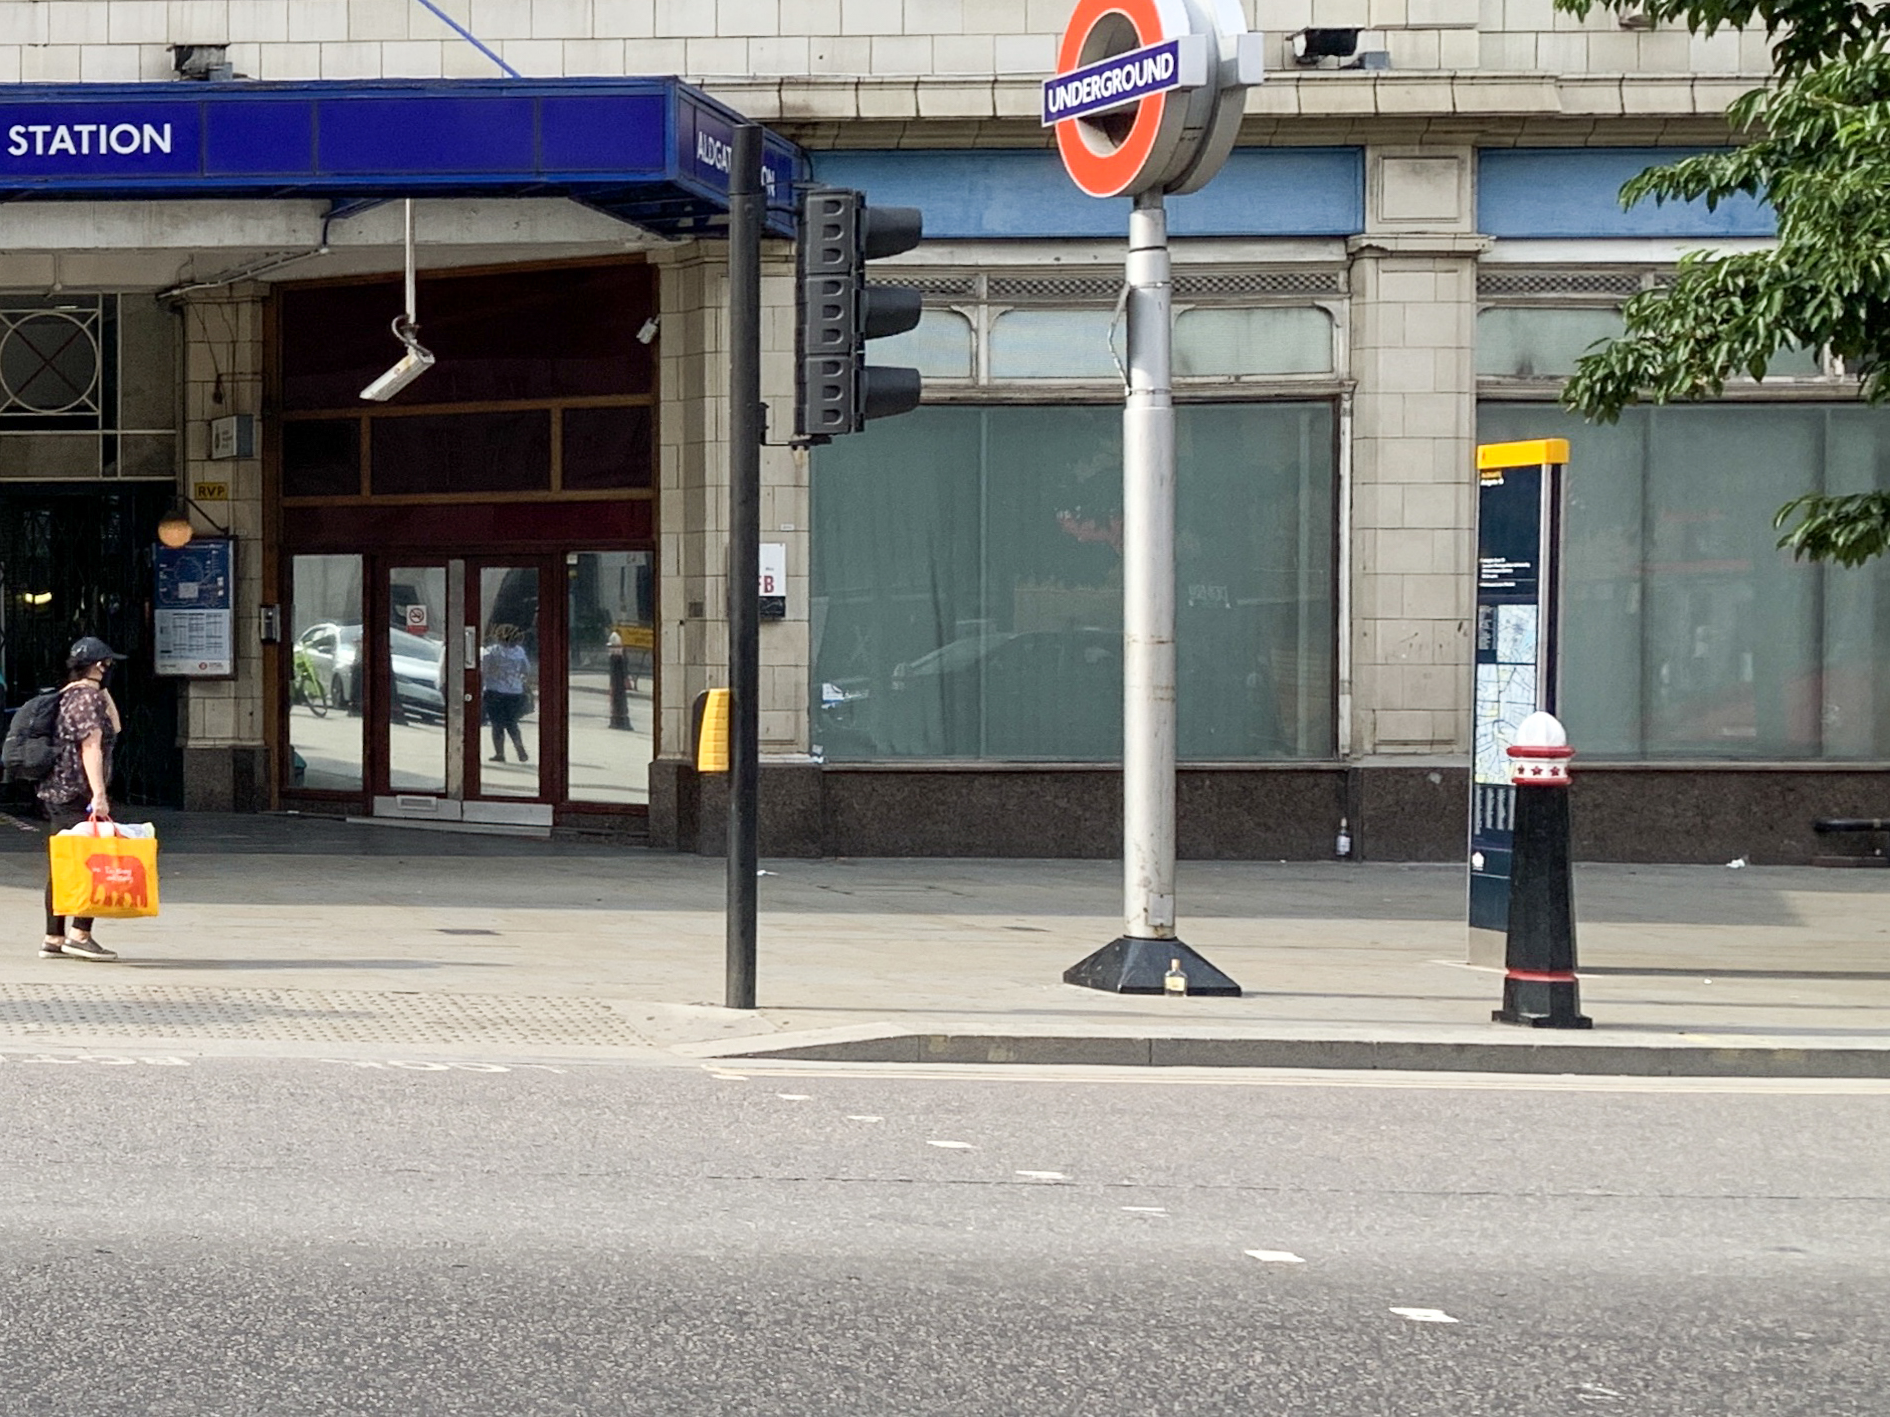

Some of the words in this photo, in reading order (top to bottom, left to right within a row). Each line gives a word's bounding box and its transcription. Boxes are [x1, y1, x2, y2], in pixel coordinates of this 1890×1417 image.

[1048, 52, 1175, 113] UNDERGROUND
[8, 123, 172, 156] STATION
[697, 132, 732, 174] ALDGAT
[198, 486, 225, 497] RVP
